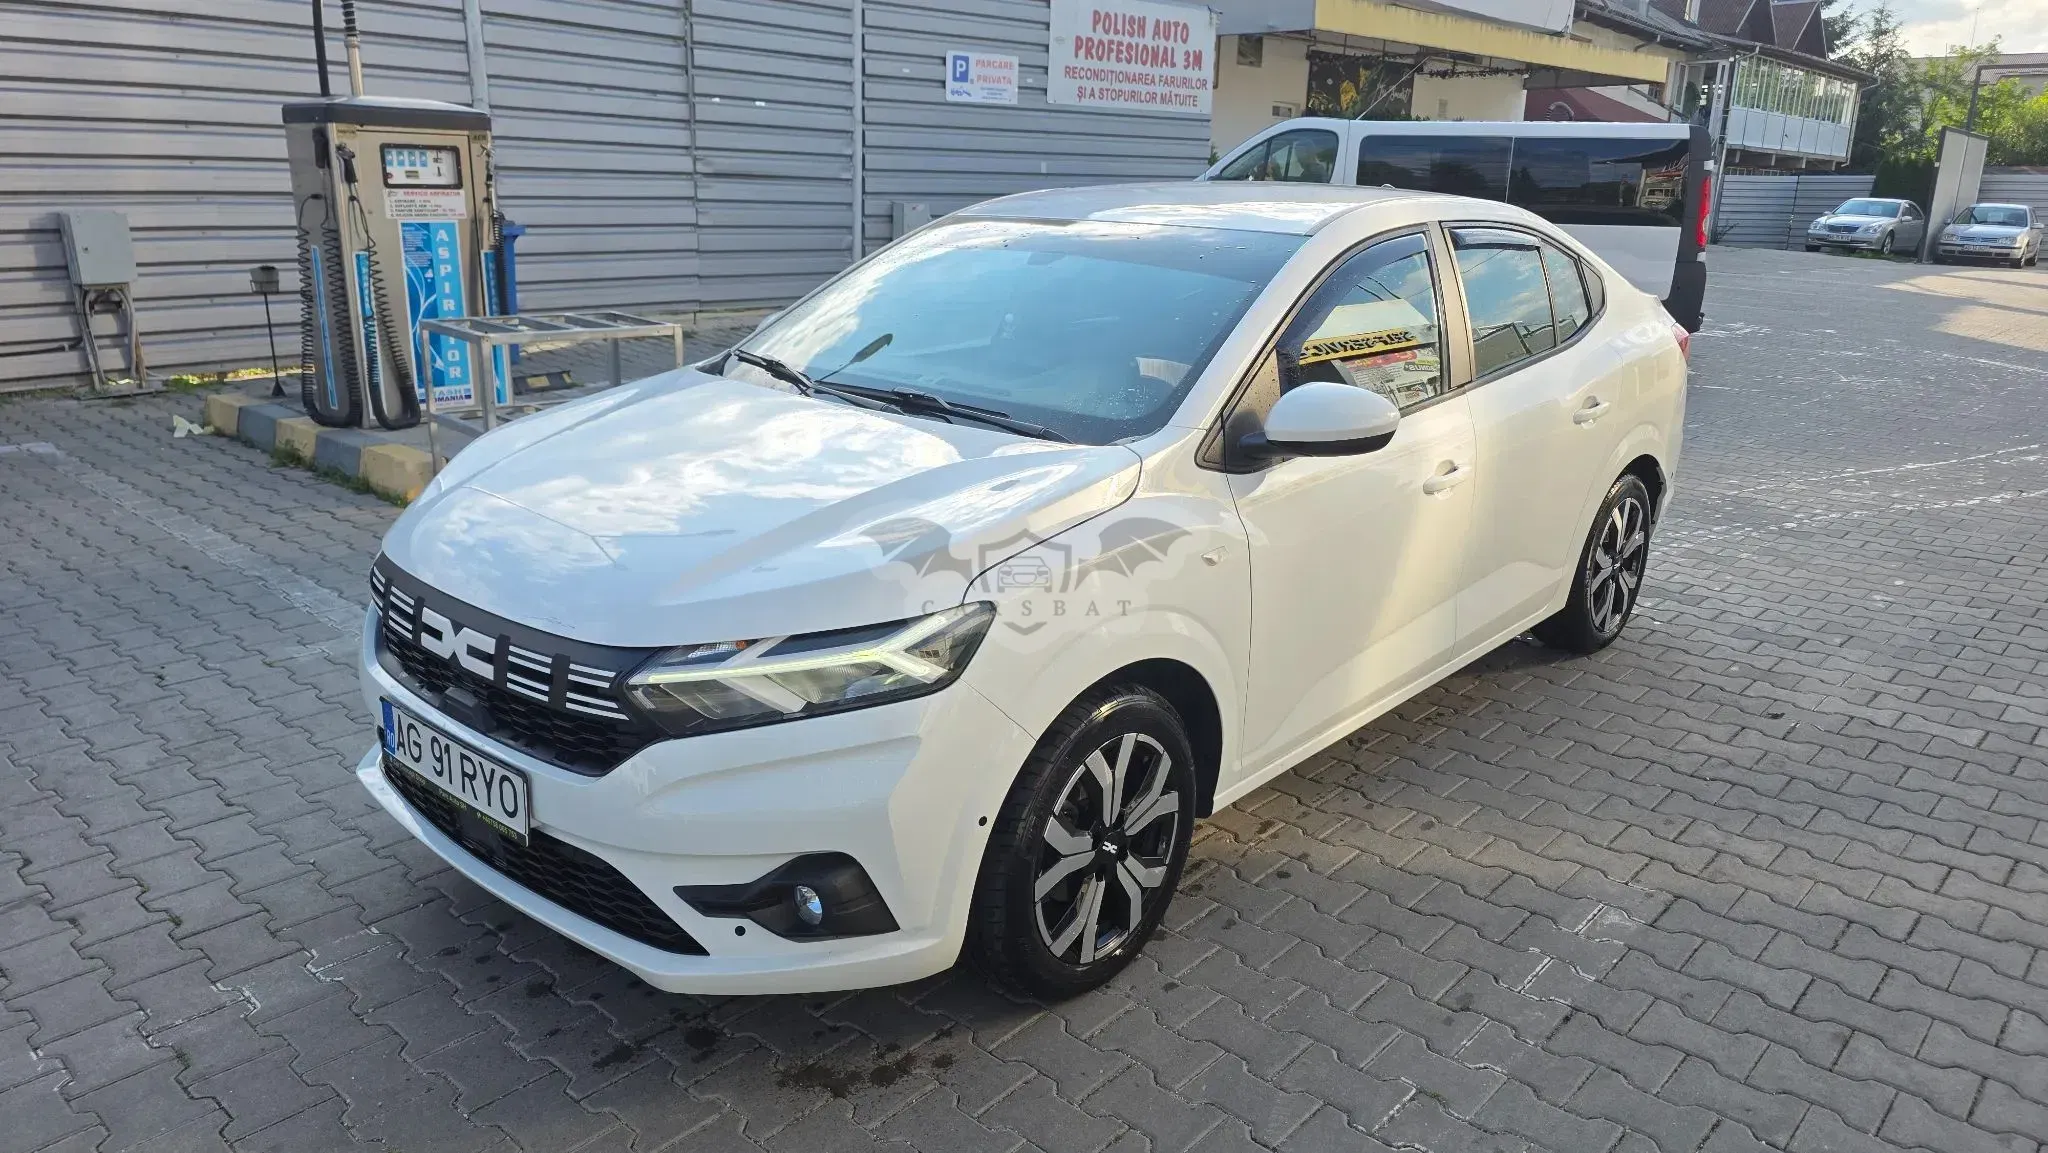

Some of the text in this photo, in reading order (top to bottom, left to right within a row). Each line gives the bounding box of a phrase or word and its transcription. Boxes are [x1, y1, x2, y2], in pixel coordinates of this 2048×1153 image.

[1092, 9, 1190, 45] POLISH AUTO
[975, 59, 1015, 71] PARCARE
[1074, 35, 1203, 72] PROFESIONAL 3M
[1158, 75, 1209, 91] FARURILOR
[1088, 88, 1096, 99] A
[1099, 88, 1158, 105] STOPURILOR
[1160, 91, 1199, 107] MĂTUITE
[436, 229, 462, 379] ASPIROR
[386, 728, 395, 748] RO
[396, 713, 423, 764] AG
[430, 735, 453, 785] 91
[459, 751, 519, 819] RYO
